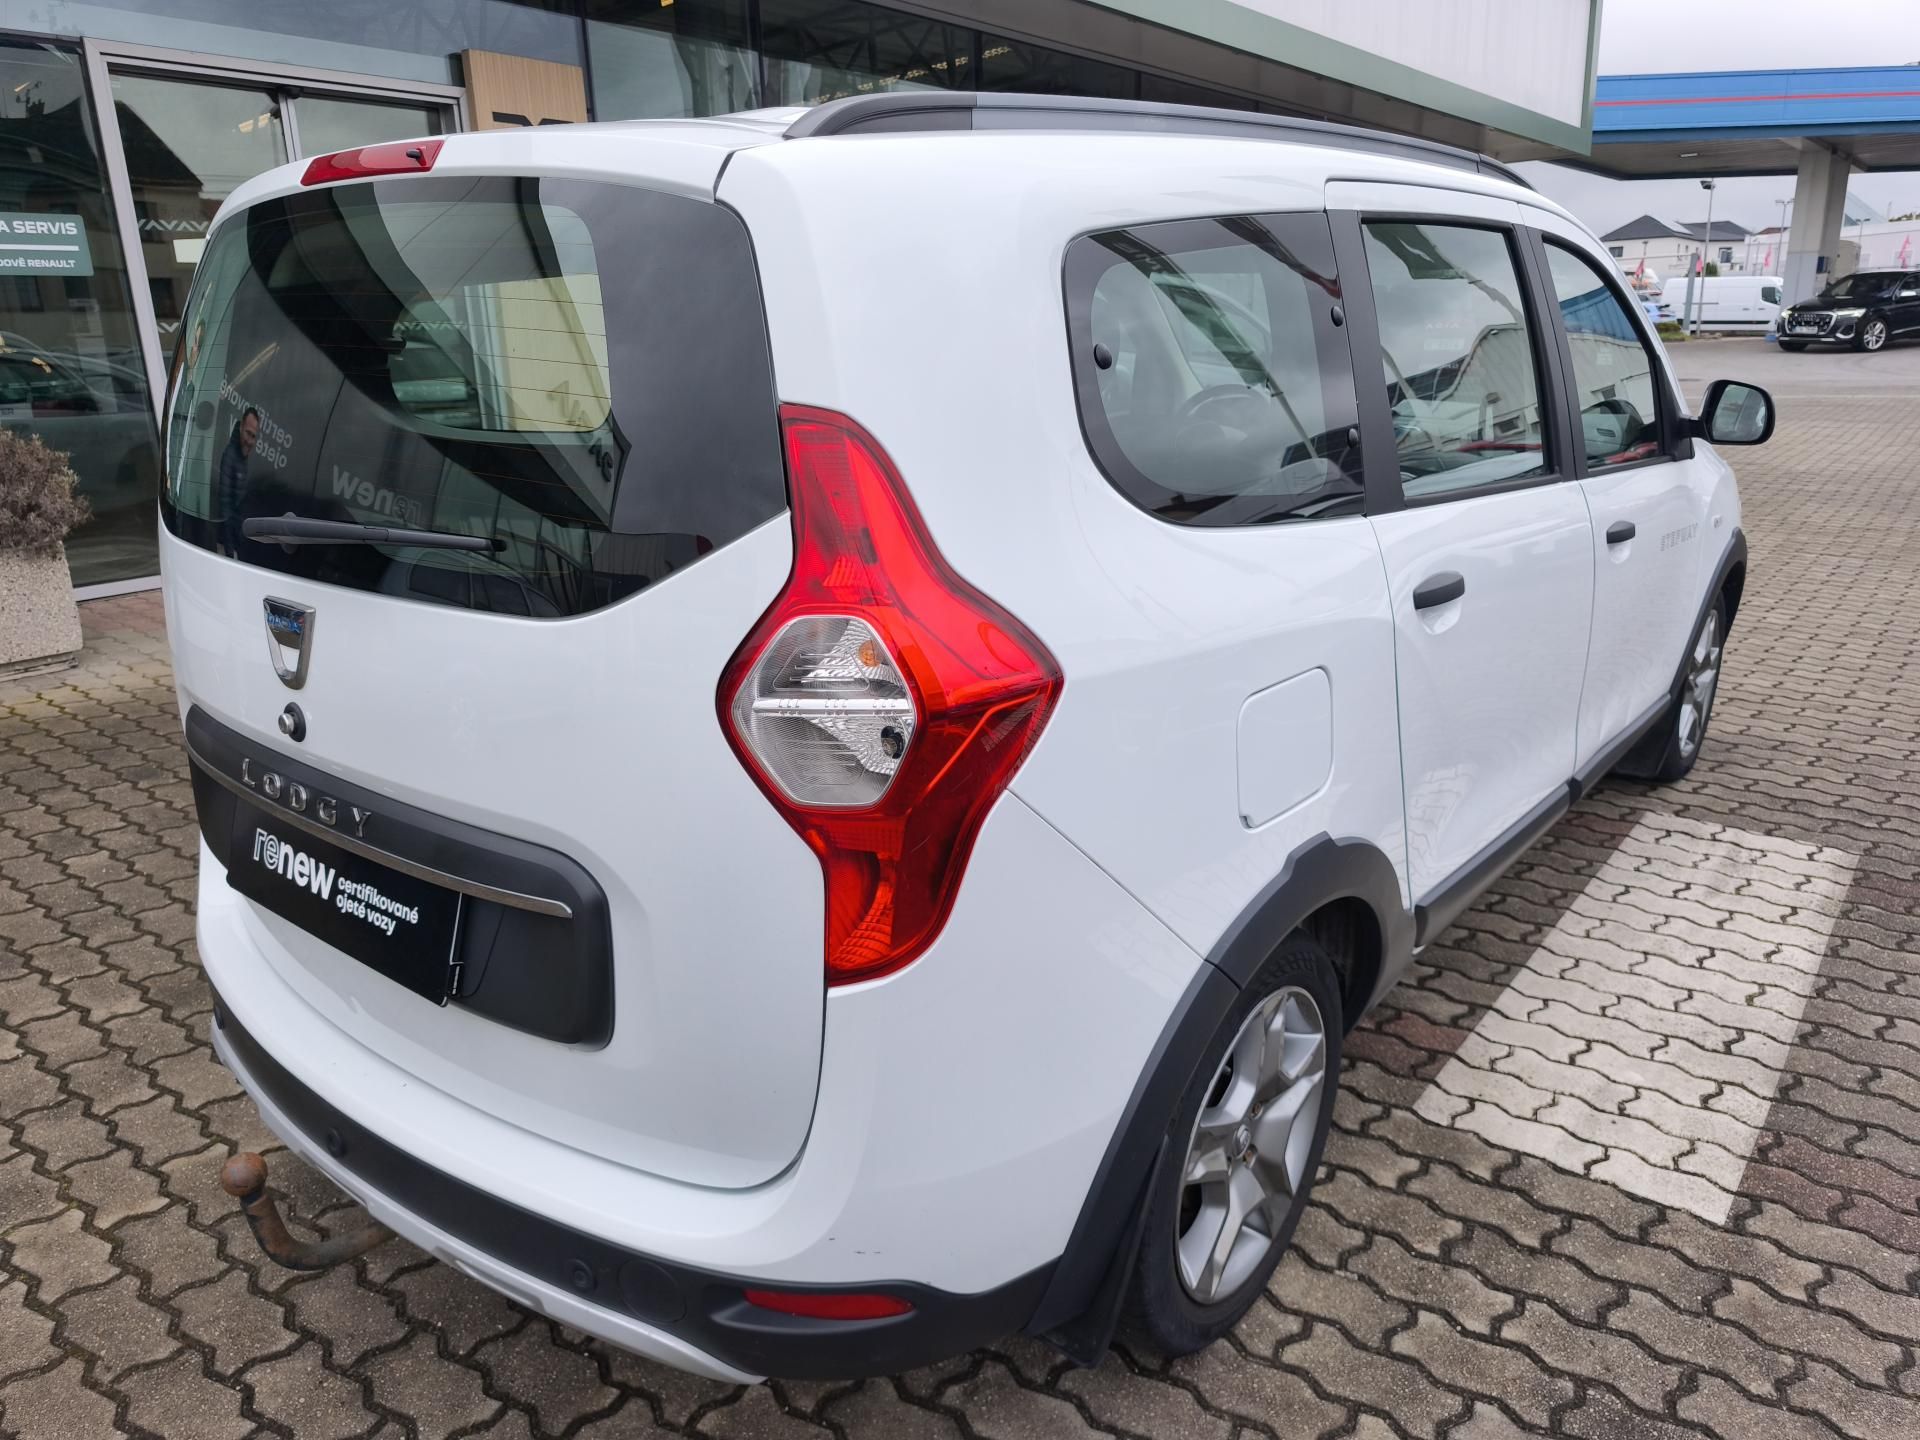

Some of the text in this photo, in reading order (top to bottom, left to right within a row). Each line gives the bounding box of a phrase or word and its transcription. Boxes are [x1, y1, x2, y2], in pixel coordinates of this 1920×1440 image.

[12, 220, 78, 235] SERVIS
[27, 259, 76, 268] RENAULT
[241, 757, 373, 838] LODGY
[252, 827, 337, 901] renew
[335, 893, 397, 937] ojeté vozy
[337, 876, 419, 925] certifikované
